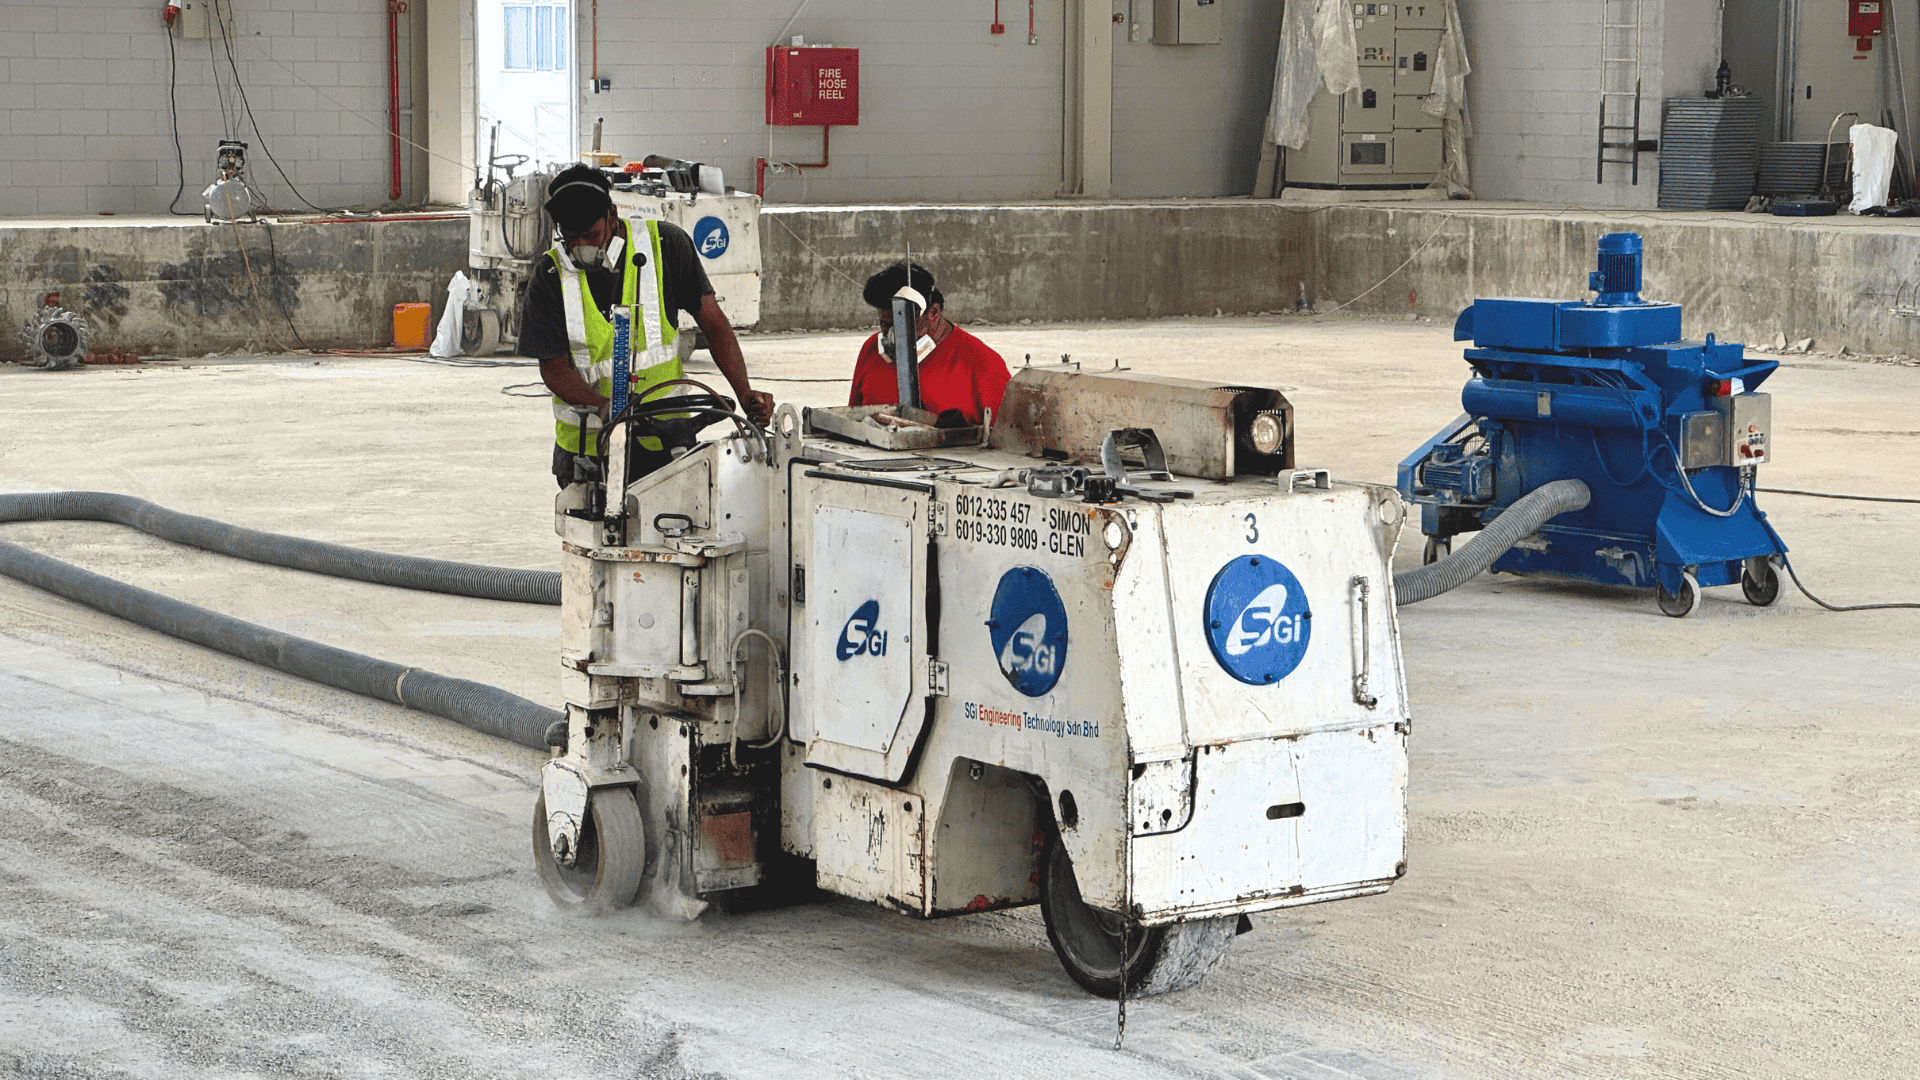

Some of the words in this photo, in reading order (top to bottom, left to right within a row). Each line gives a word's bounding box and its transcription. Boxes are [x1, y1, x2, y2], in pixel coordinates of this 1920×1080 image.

[819, 68, 841, 78] FIRE
[819, 79, 847, 89] HOSE
[819, 90, 845, 100] REEL
[956, 494, 1007, 521] 6012-335
[1010, 502, 1031, 525] 457
[1049, 508, 1091, 536] SIMON
[1244, 512, 1259, 544] 3
[956, 519, 1007, 547] 6019-330
[1010, 526, 1038, 550] 9809
[1049, 532, 1084, 558] GLEN
[964, 701, 978, 720] SGi
[979, 704, 1022, 732] Engineering
[1023, 711, 1065, 738] Technology
[1066, 719, 1082, 736] Sdn
[1083, 719, 1099, 738] Bhd
